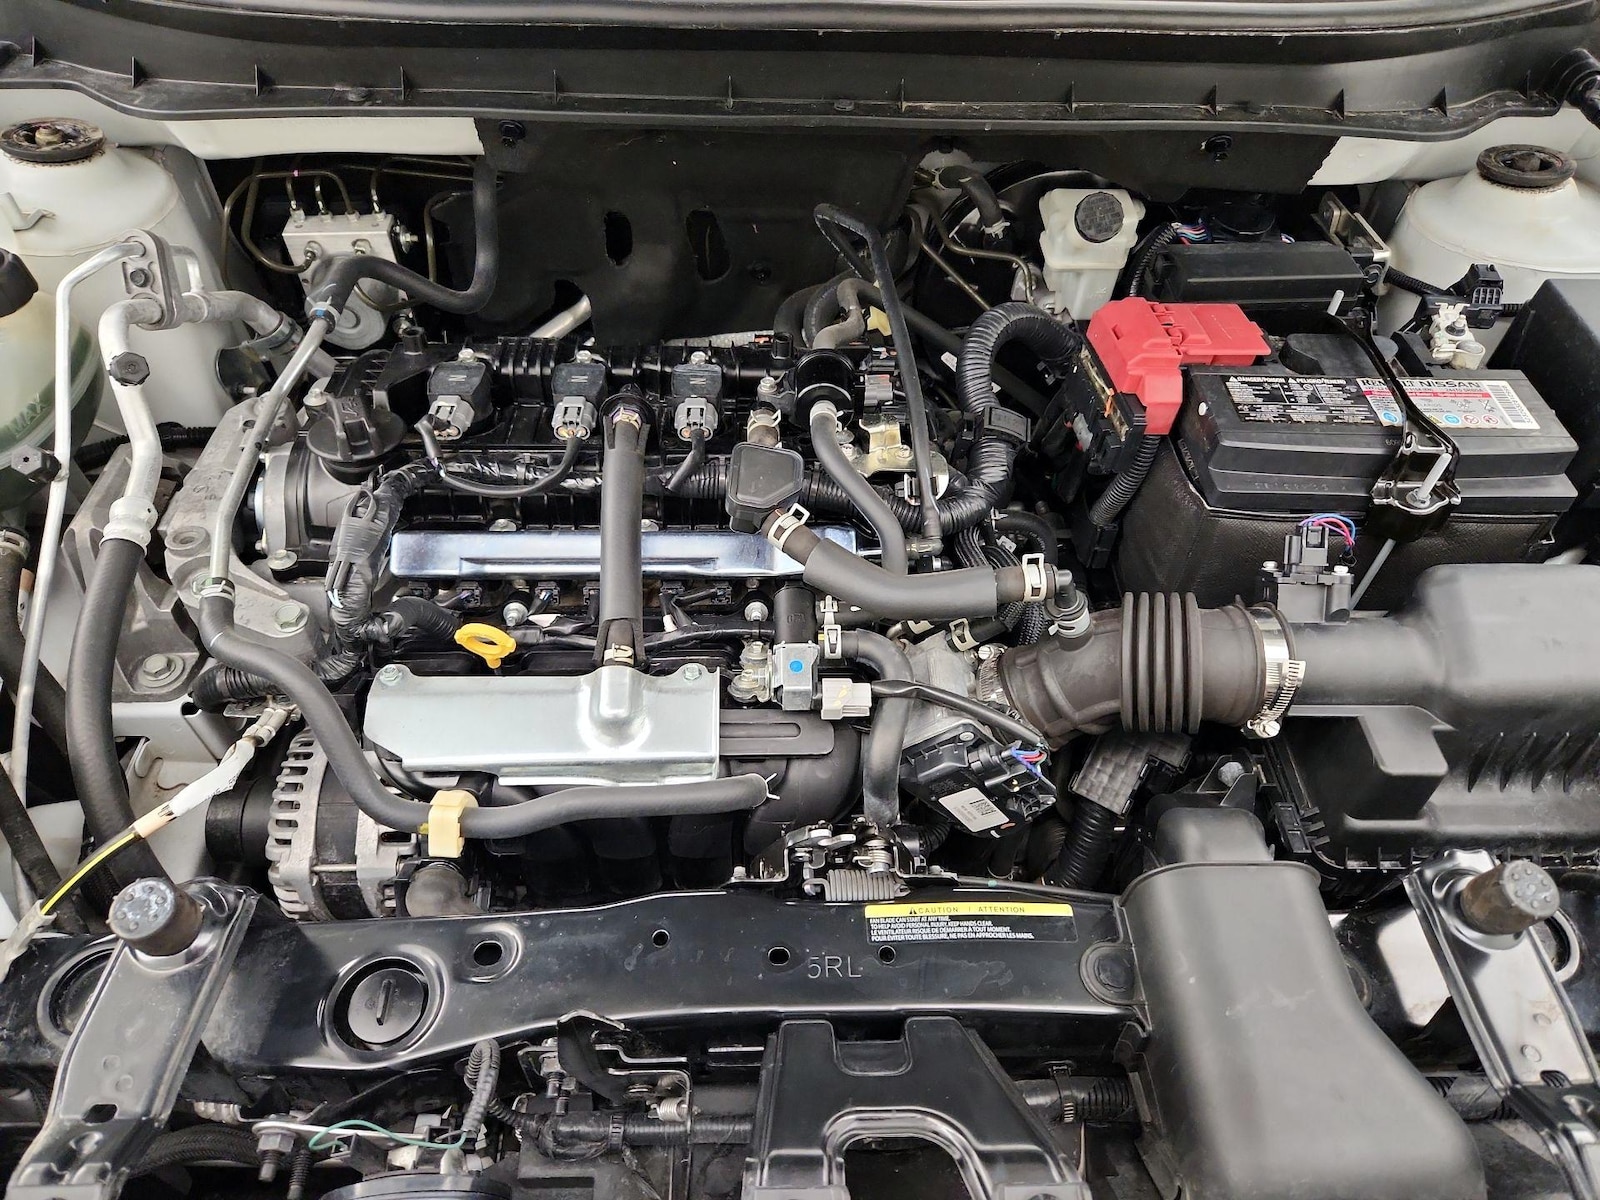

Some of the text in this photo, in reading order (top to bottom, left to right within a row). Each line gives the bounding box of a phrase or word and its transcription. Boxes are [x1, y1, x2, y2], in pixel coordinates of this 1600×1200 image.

[917, 906, 959, 914] CAUTION
[978, 906, 1026, 914] ATTENTION
[807, 955, 862, 979] 5RL
